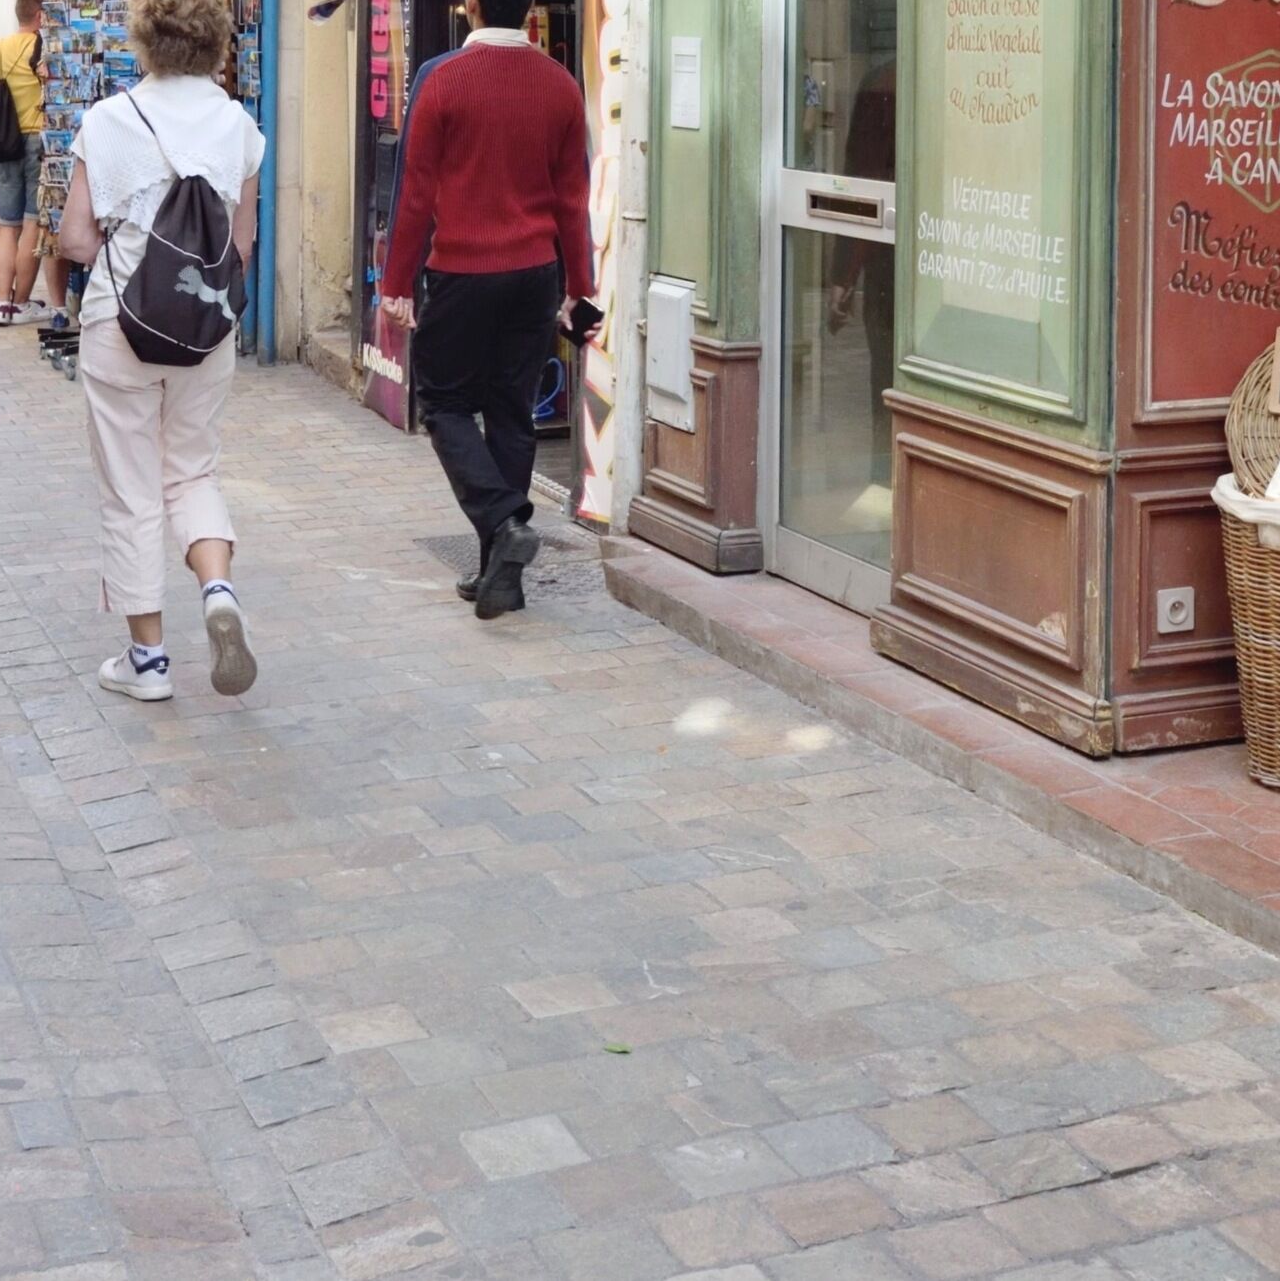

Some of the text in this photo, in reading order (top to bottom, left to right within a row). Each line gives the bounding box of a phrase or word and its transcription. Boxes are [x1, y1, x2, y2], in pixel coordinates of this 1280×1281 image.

[1161, 73, 1194, 108] LA
[1205, 150, 1224, 185] À
[953, 177, 1032, 220] VÉRITABLE
[917, 211, 1065, 264] SAVON de MARSEILLE
[918, 249, 976, 285] GARANTI
[1169, 261, 1213, 298] des
